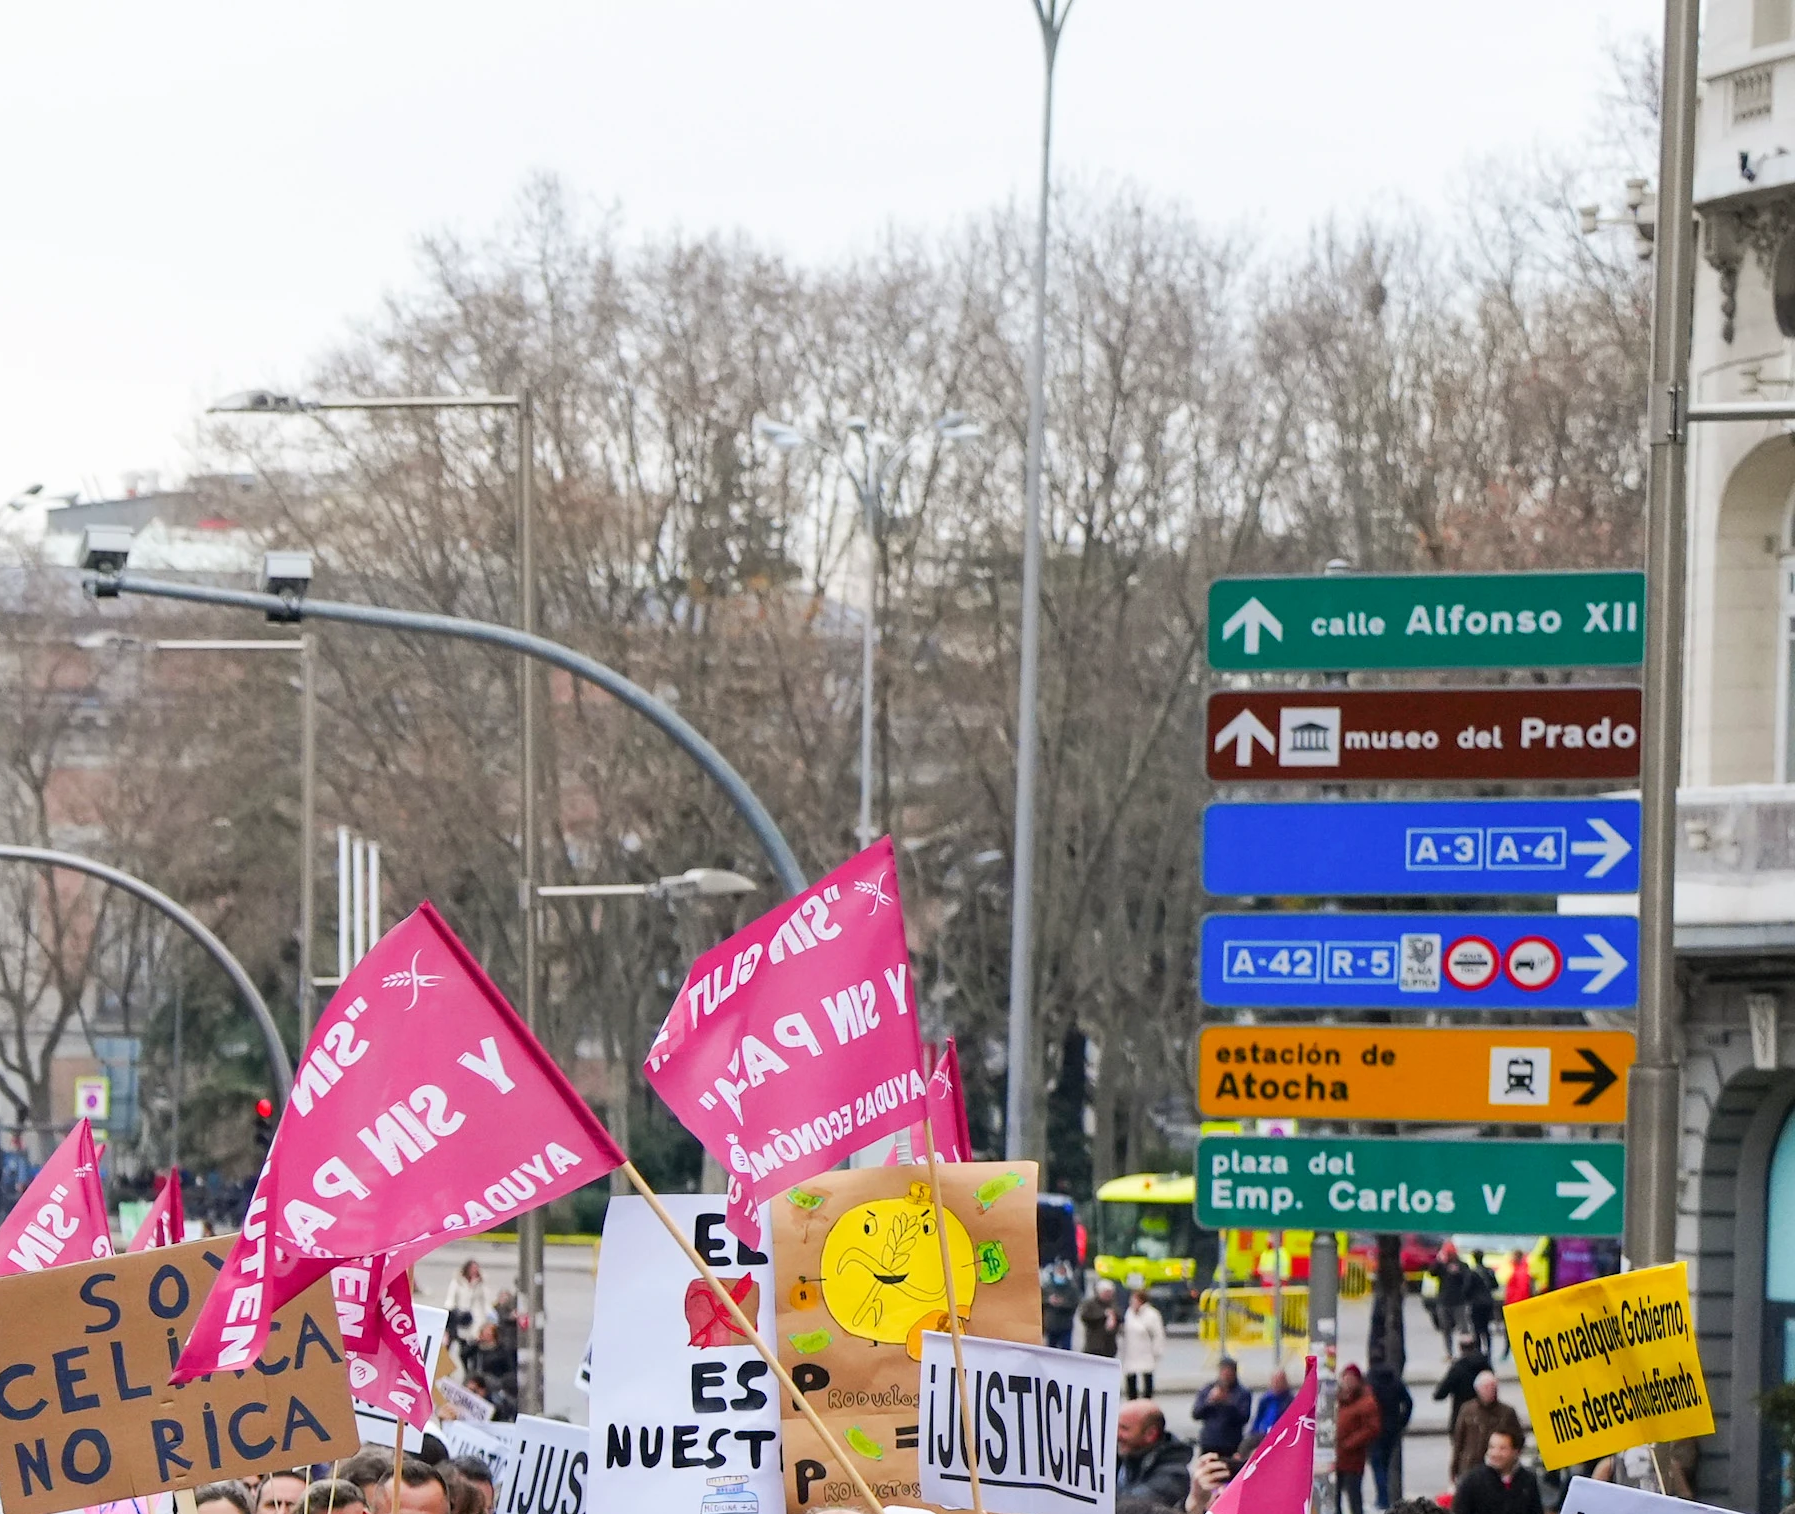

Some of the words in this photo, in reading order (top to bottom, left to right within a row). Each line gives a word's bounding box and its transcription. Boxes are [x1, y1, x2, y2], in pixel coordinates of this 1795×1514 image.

[1312, 612, 1386, 637] calle
[1405, 604, 1562, 635] Alfonso
[1582, 602, 1638, 634] XII
[1344, 727, 1439, 751] museo
[1456, 725, 1502, 749] del
[1520, 716, 1637, 748] Prado
[1414, 836, 1475, 863] A-3
[1495, 836, 1557, 863] A-4
[1231, 948, 1313, 976] A-42
[1331, 948, 1392, 976] R-5
[1216, 1040, 1341, 1066] estación
[1360, 1044, 1396, 1067] de
[1215, 1071, 1349, 1101] Atocha
[1211, 1152, 1289, 1178] plaza
[1308, 1152, 1355, 1176] del
[1211, 1182, 1303, 1216] Emp.
[1328, 1182, 1456, 1214] Carlos
[1481, 1183, 1507, 1214] V
[1522, 1322, 1557, 1377] Con
[691, 1360, 769, 1414] ES
[1549, 1398, 1583, 1445] mis
[14, 1427, 111, 1497] NO
